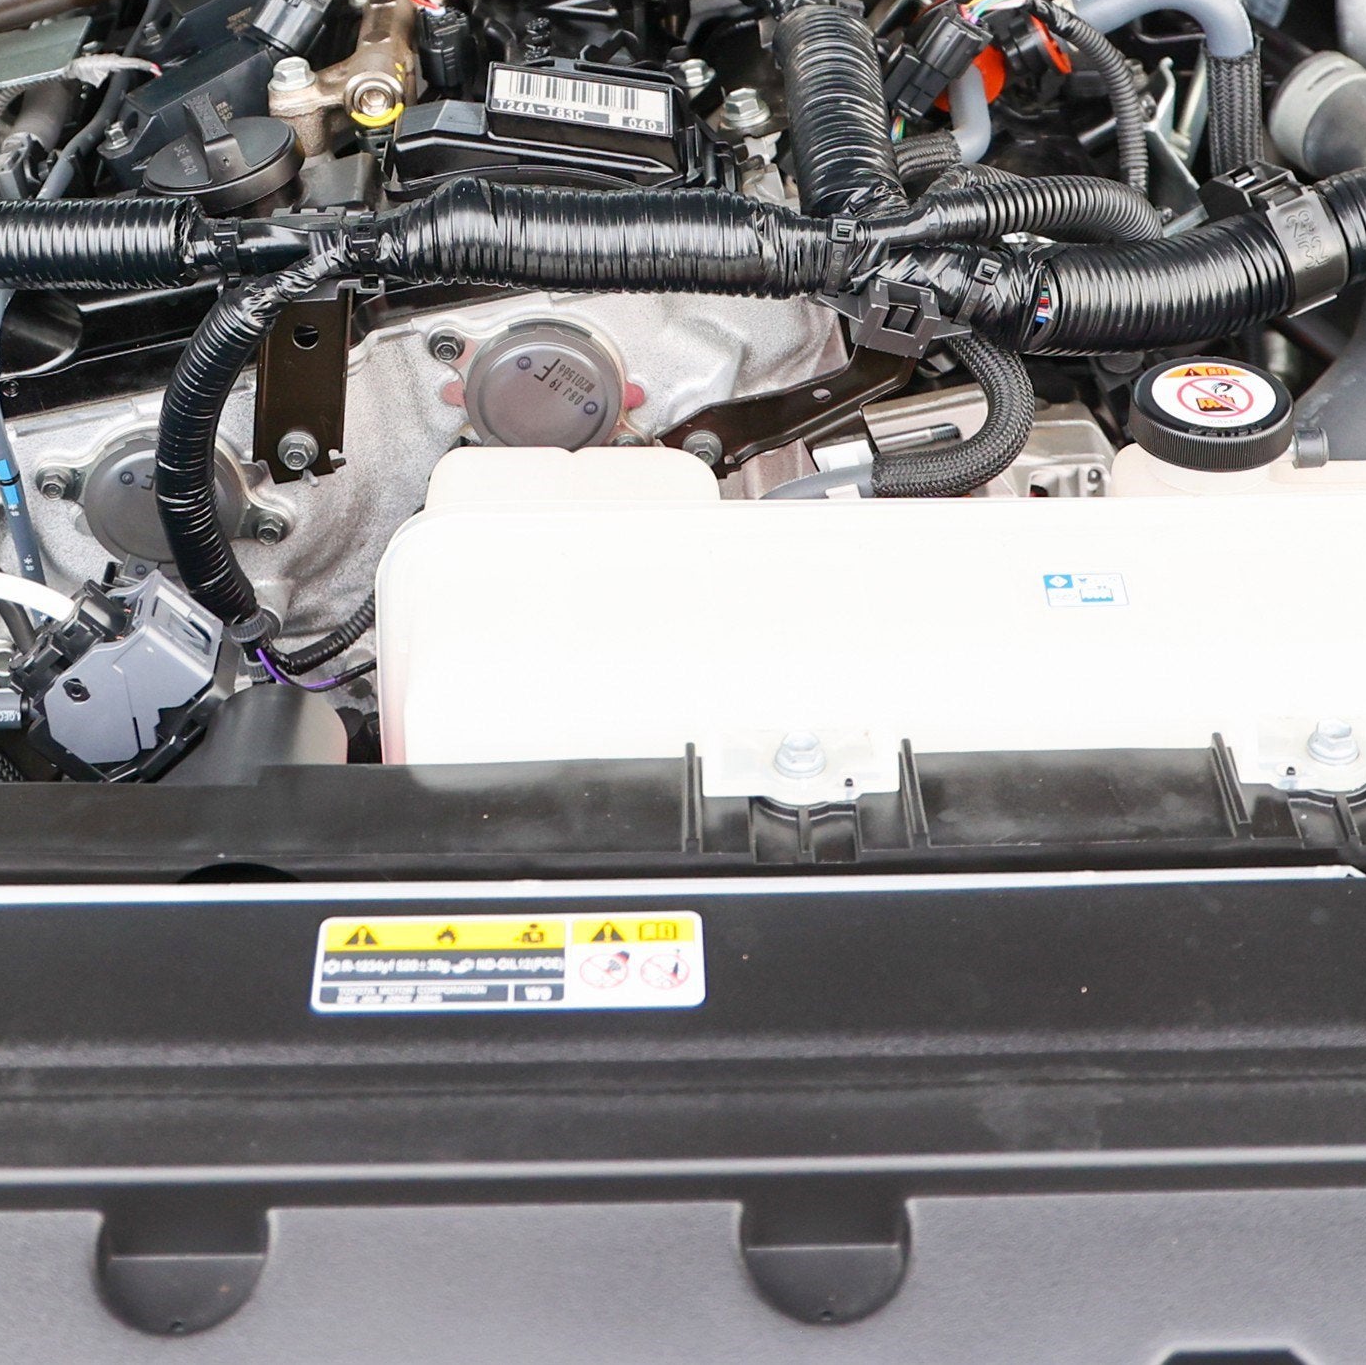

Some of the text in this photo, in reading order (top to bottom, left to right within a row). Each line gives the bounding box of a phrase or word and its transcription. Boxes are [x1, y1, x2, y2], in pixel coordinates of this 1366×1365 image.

[497, 99, 585, 121] T24A-T83C
[628, 118, 657, 130] 040
[534, 358, 561, 382] F
[549, 378, 563, 391] 19
